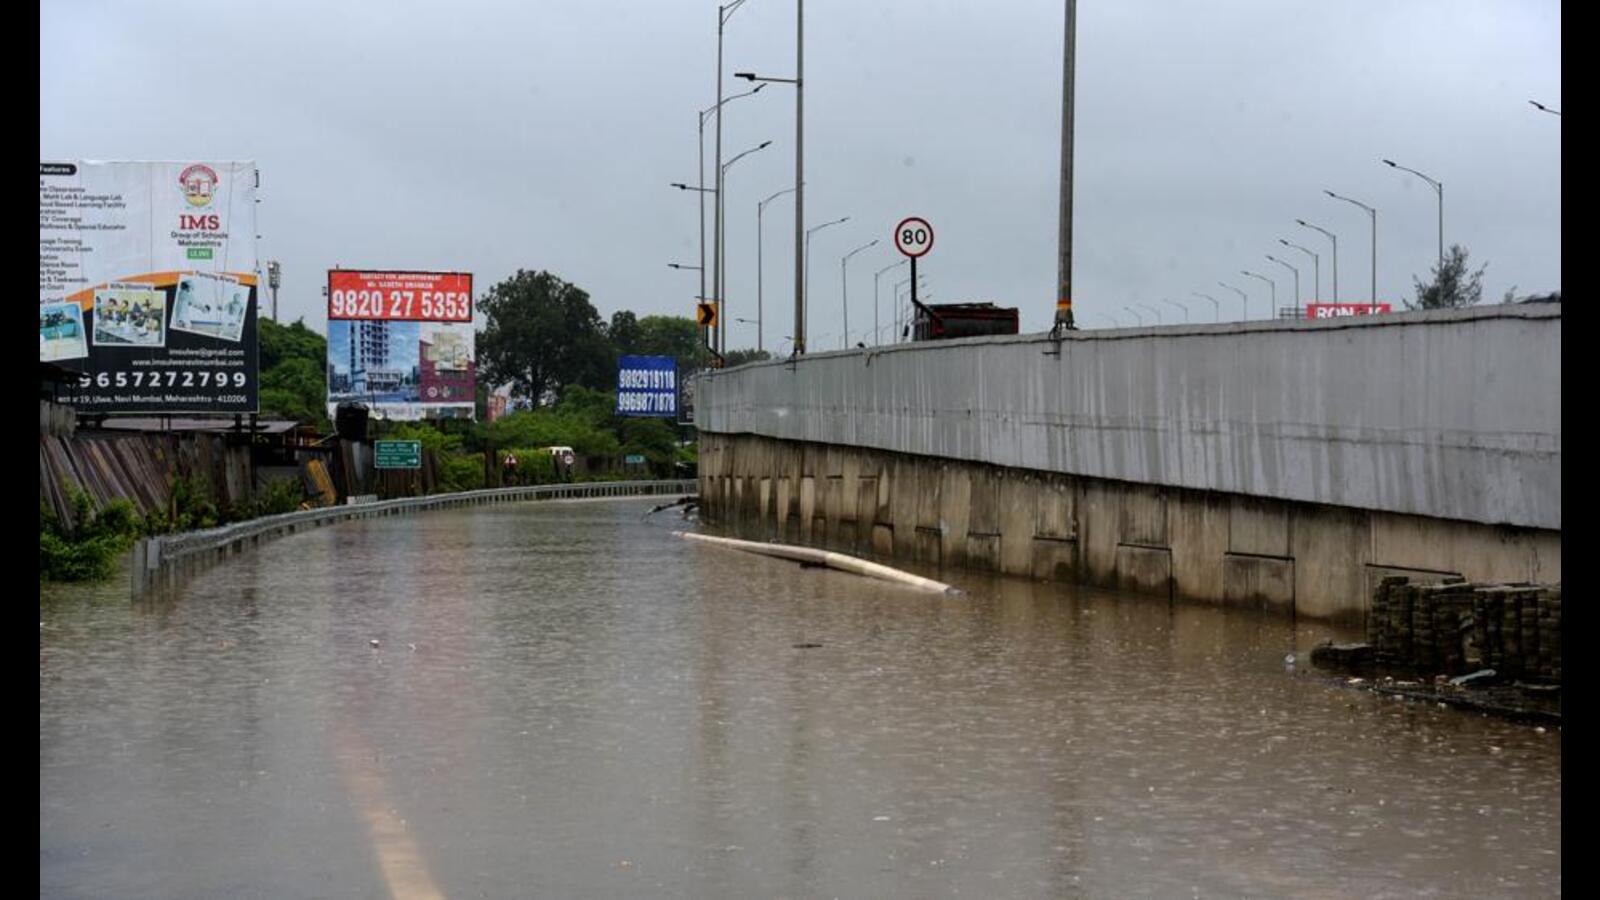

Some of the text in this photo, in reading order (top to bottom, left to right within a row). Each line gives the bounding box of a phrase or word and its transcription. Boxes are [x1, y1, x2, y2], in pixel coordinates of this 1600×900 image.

[180, 215, 220, 230] IMS
[171, 231, 191, 240] Group
[201, 231, 228, 239] Schools
[903, 229, 926, 245] 80
[332, 289, 469, 318] 9820 27 5353
[165, 395, 212, 403] Maharashtra
